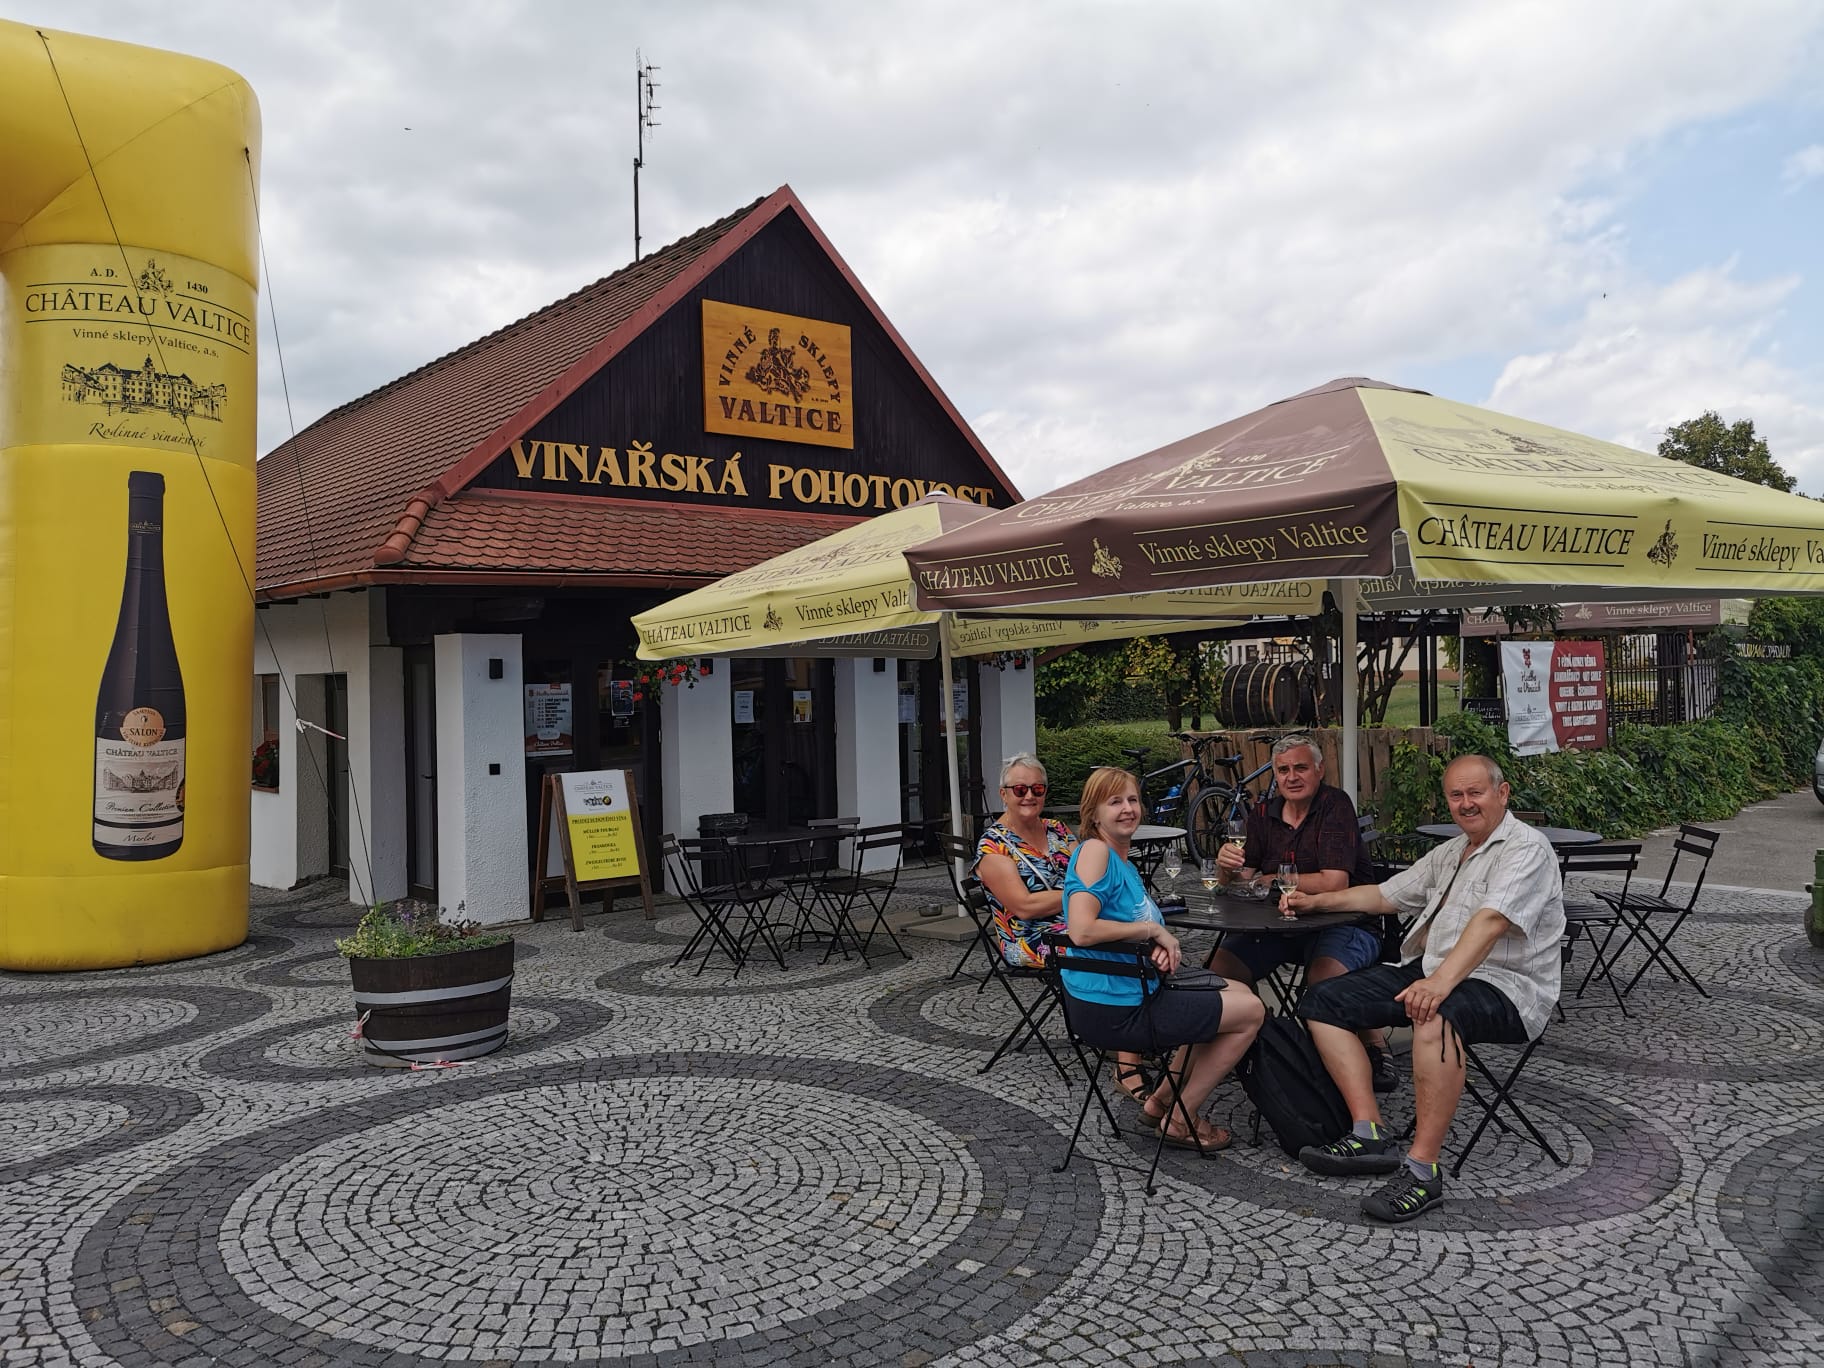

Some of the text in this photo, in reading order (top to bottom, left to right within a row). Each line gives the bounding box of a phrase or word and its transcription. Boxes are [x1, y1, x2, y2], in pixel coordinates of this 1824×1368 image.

[186, 280, 209, 294] 1430
[25, 288, 251, 346] CHÂTEAU VALTICE
[72, 328, 110, 340] Vinné
[112, 330, 155, 347] sklepy
[719, 324, 842, 404] VINNÉ SKLEPY
[88, 418, 148, 441] Rodinné
[718, 394, 843, 434] VALTICE
[510, 440, 749, 497] VINAŘSKÁ
[1165, 454, 1339, 490] VALTICE
[1138, 520, 1369, 566] Vinné sklepy Valtice
[1416, 512, 1636, 556] CHÂTEAU VALTICE
[1701, 533, 1749, 561] Vinné
[1747, 536, 1801, 572] sklepy
[919, 553, 1075, 591] CHÂTEAU VALTICE
[795, 588, 909, 622] Vinné sklepy Valt
[1637, 604, 1673, 617] sklepy
[1675, 602, 1712, 613] Valtice
[641, 614, 752, 646] CHÂTEAU VALTICE
[129, 728, 158, 737] SALON
